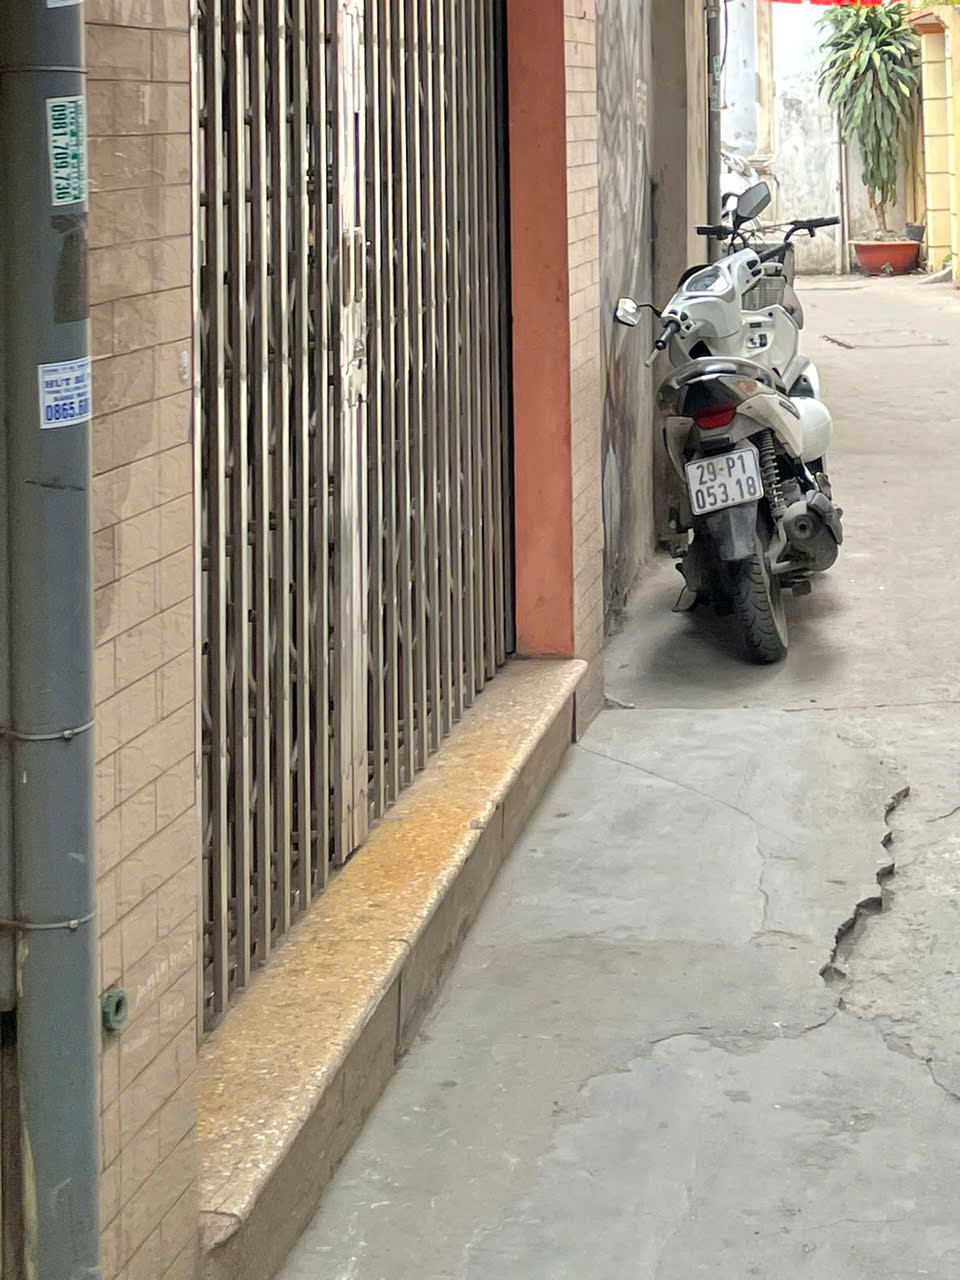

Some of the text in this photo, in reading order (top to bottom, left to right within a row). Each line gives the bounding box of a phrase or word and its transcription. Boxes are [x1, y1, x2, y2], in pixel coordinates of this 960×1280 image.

[51, 104, 70, 200] 0981.709.736
[696, 454, 746, 486] 29-P1
[695, 476, 757, 510] 053.18
